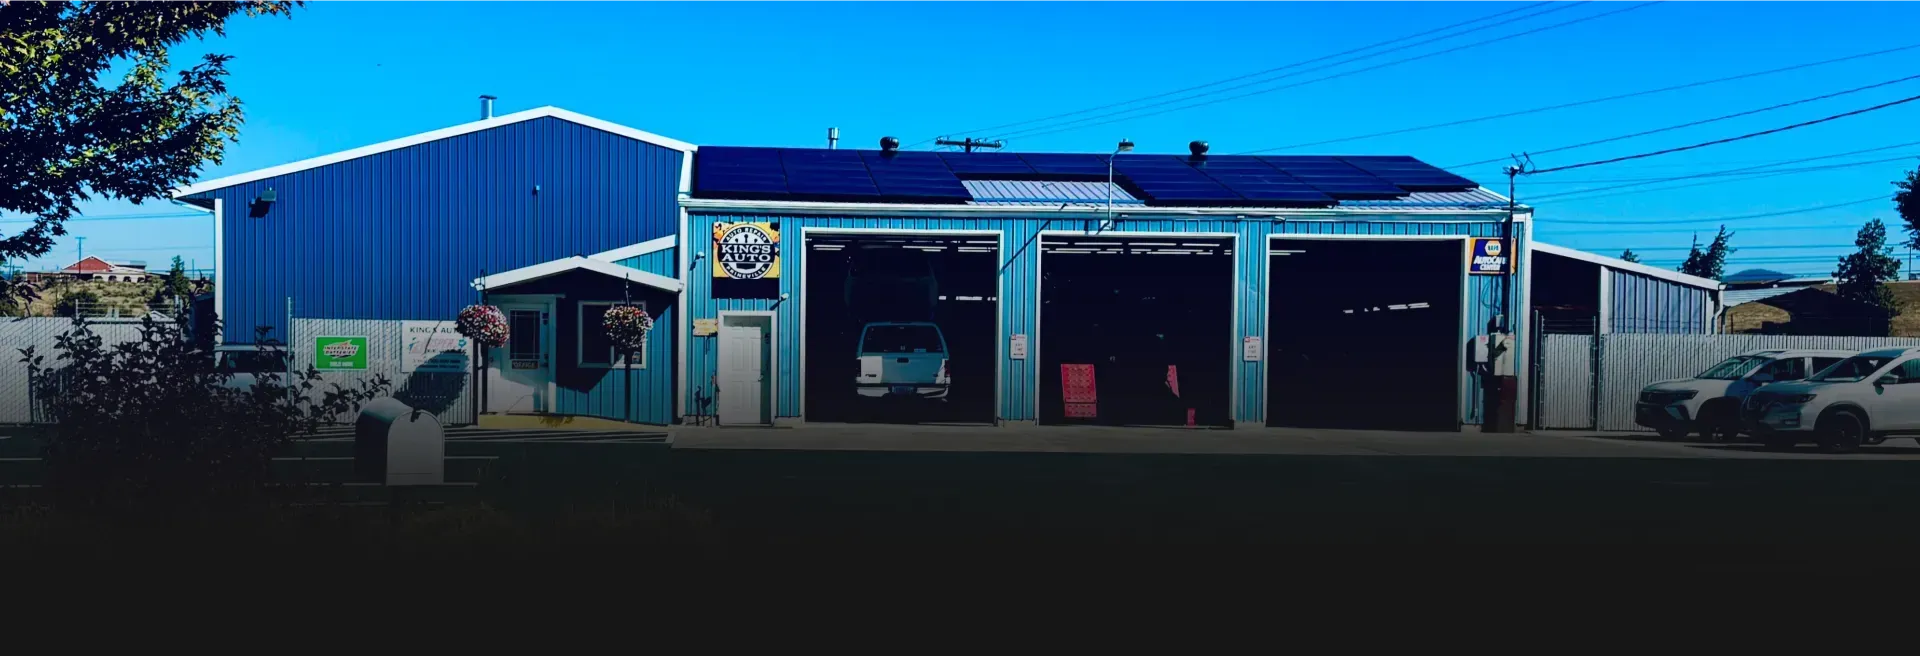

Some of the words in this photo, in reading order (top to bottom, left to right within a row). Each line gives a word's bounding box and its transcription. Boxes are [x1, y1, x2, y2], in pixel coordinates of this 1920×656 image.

[726, 228, 742, 241] AUTO
[745, 228, 767, 241] REPAIR
[721, 244, 771, 253] KING'S
[721, 253, 771, 262] AUTO
[726, 266, 766, 278] PRINEVILLE
